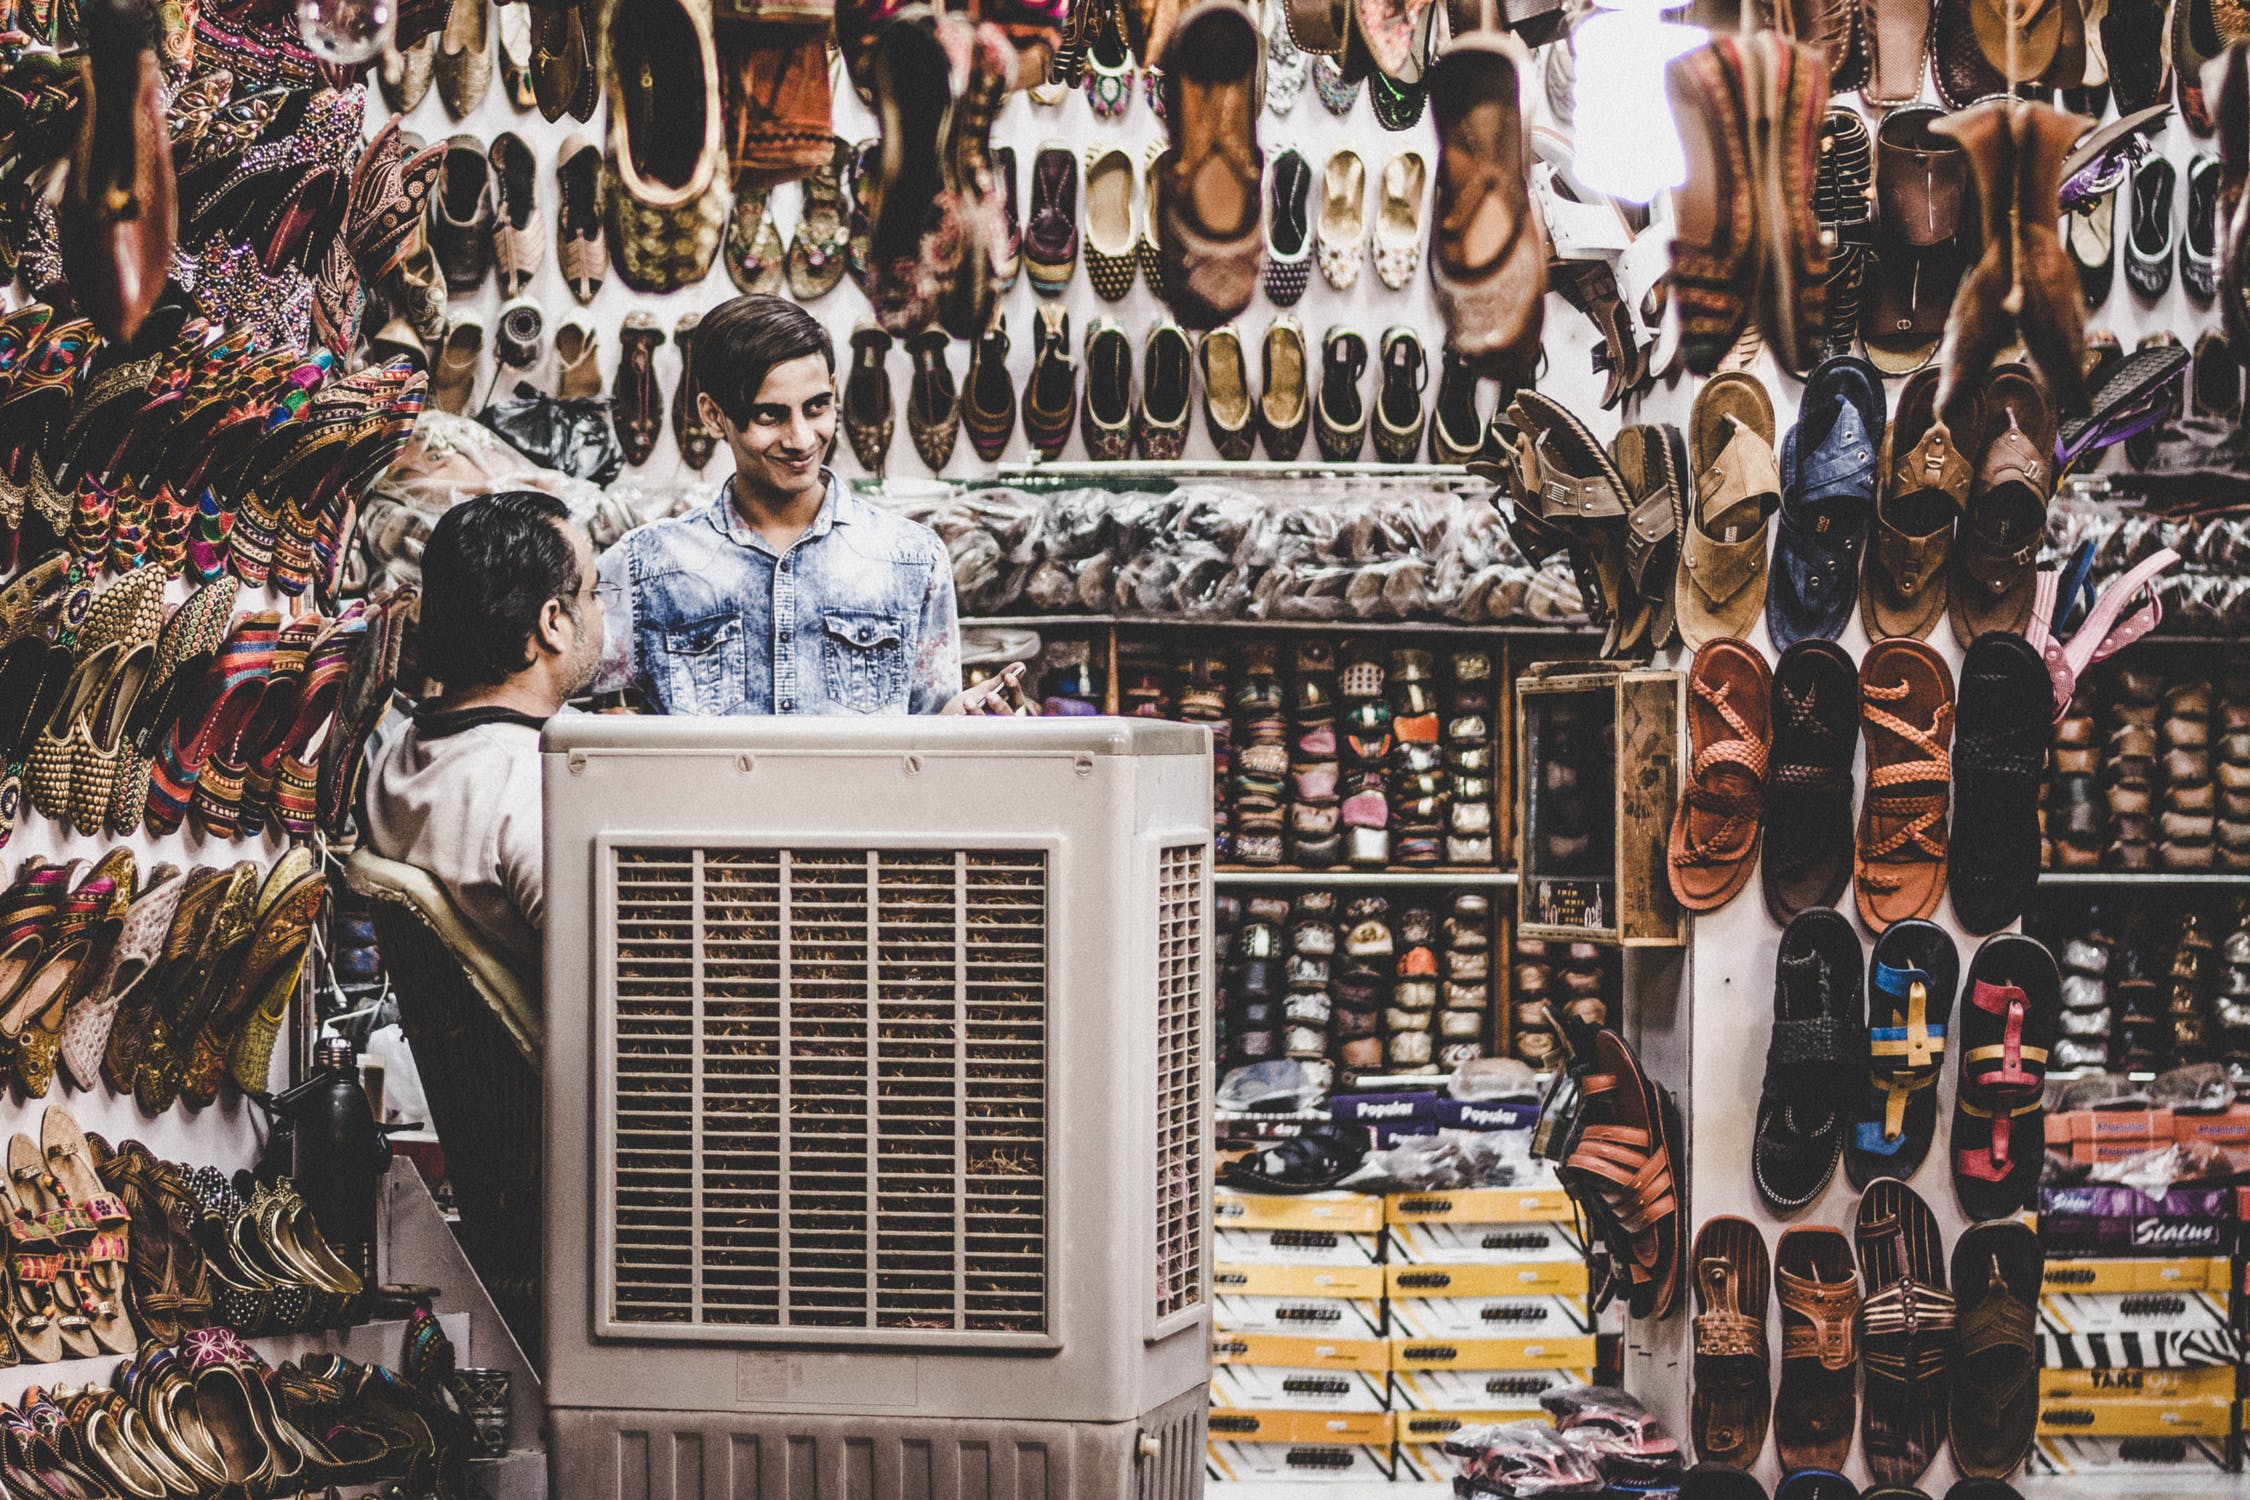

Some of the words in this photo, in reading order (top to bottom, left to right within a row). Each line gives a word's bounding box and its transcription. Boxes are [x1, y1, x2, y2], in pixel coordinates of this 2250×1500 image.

[1355, 1101, 1414, 1119] Popular
[1460, 1105, 1518, 1125] Popular
[2135, 1218, 2215, 1244] Status
[2091, 1370, 2143, 1388] TAKE
